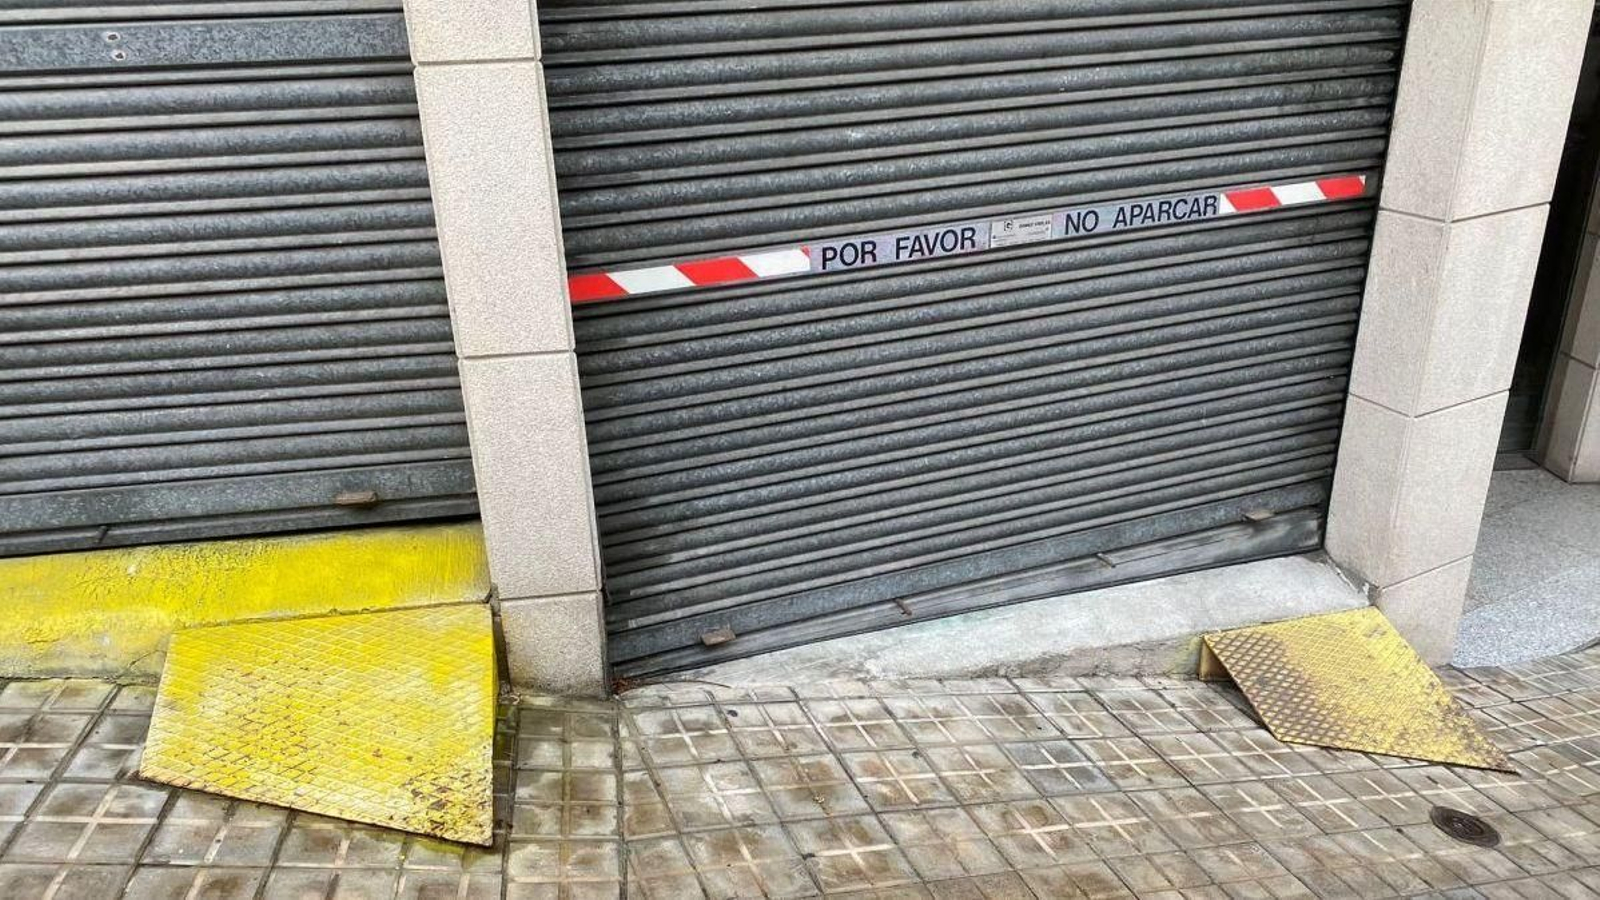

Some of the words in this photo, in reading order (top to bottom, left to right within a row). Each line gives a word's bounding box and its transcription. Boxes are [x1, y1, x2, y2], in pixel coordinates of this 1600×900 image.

[821, 240, 877, 271] POR
[895, 226, 976, 260] FAVOR
[1064, 210, 1099, 236] NO
[1112, 195, 1218, 229] APARCAR
